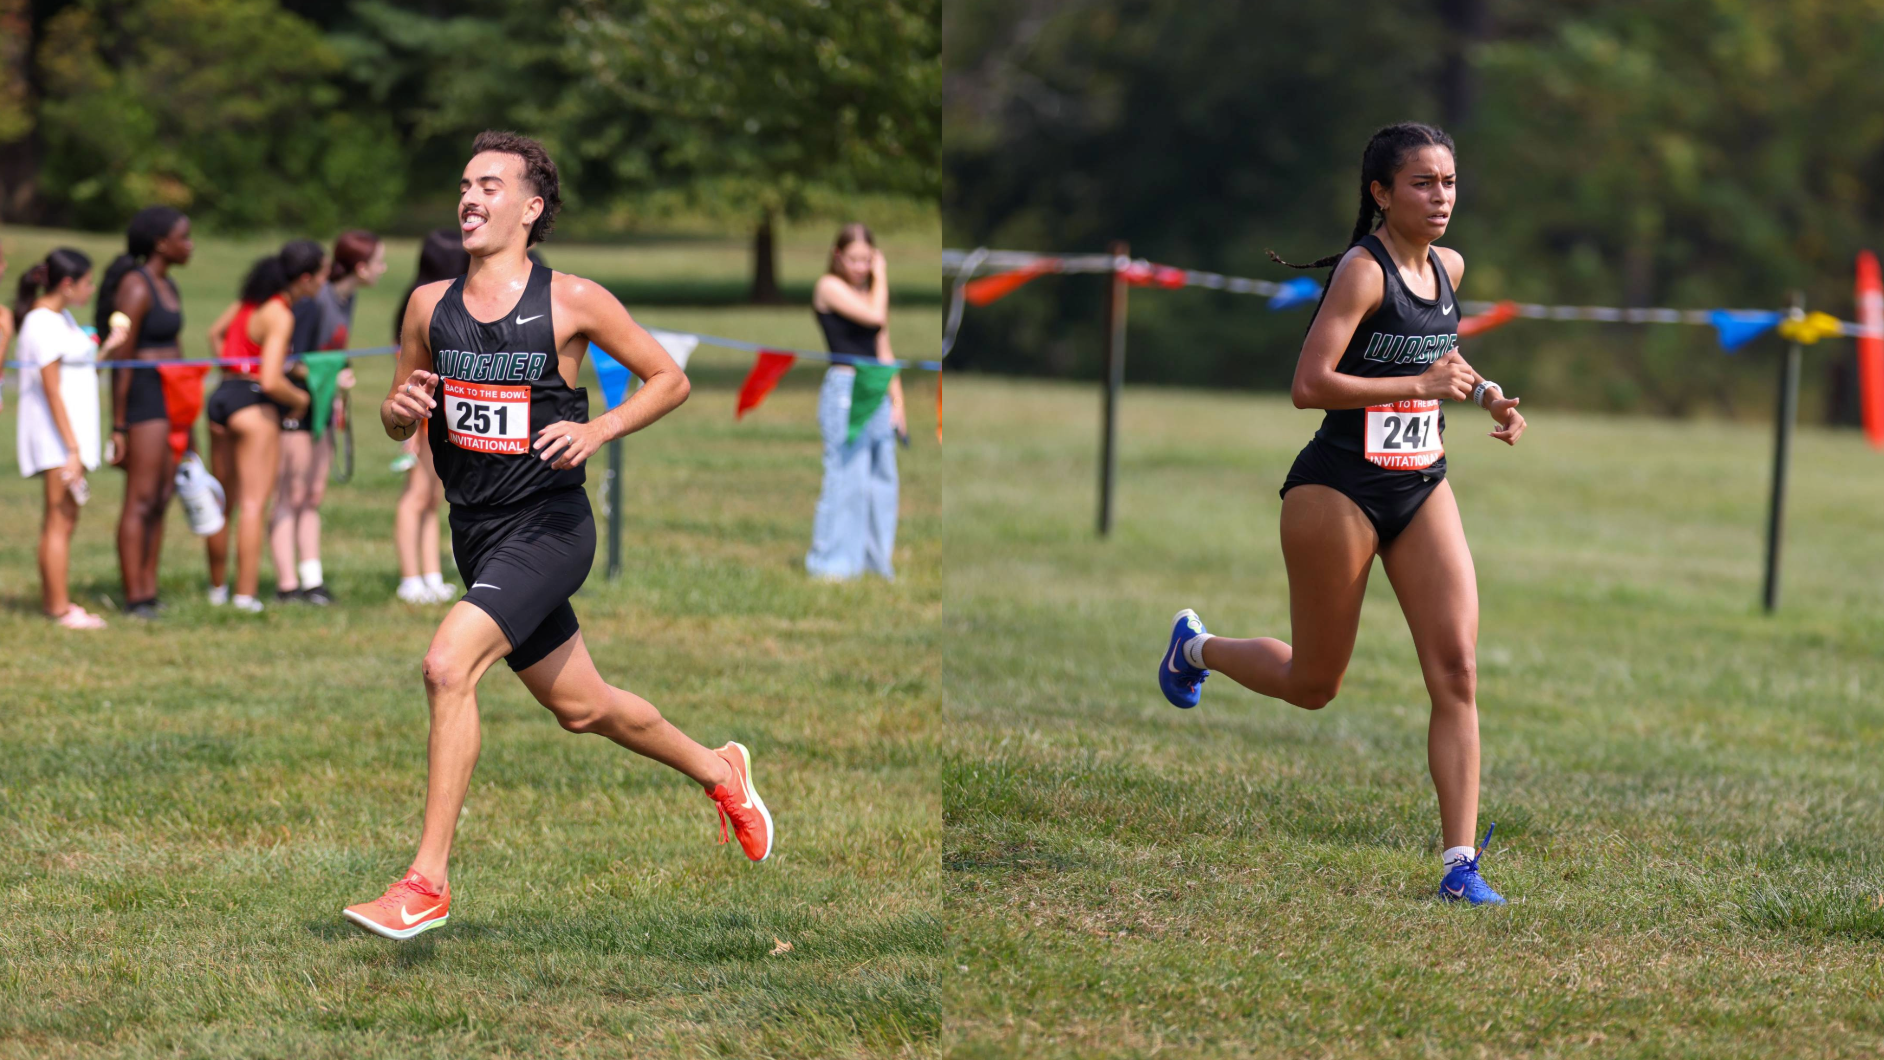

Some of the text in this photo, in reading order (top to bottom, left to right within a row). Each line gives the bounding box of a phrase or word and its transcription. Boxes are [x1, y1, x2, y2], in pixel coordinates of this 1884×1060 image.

[437, 350, 547, 381] WAGNER
[445, 384, 527, 399] BACK TO THE BOWL
[1399, 400, 1410, 408] TO
[1413, 400, 1426, 408] THE
[456, 401, 508, 435] 251
[450, 433, 524, 452] INVITATIONAL
[1382, 415, 1431, 449] 241
